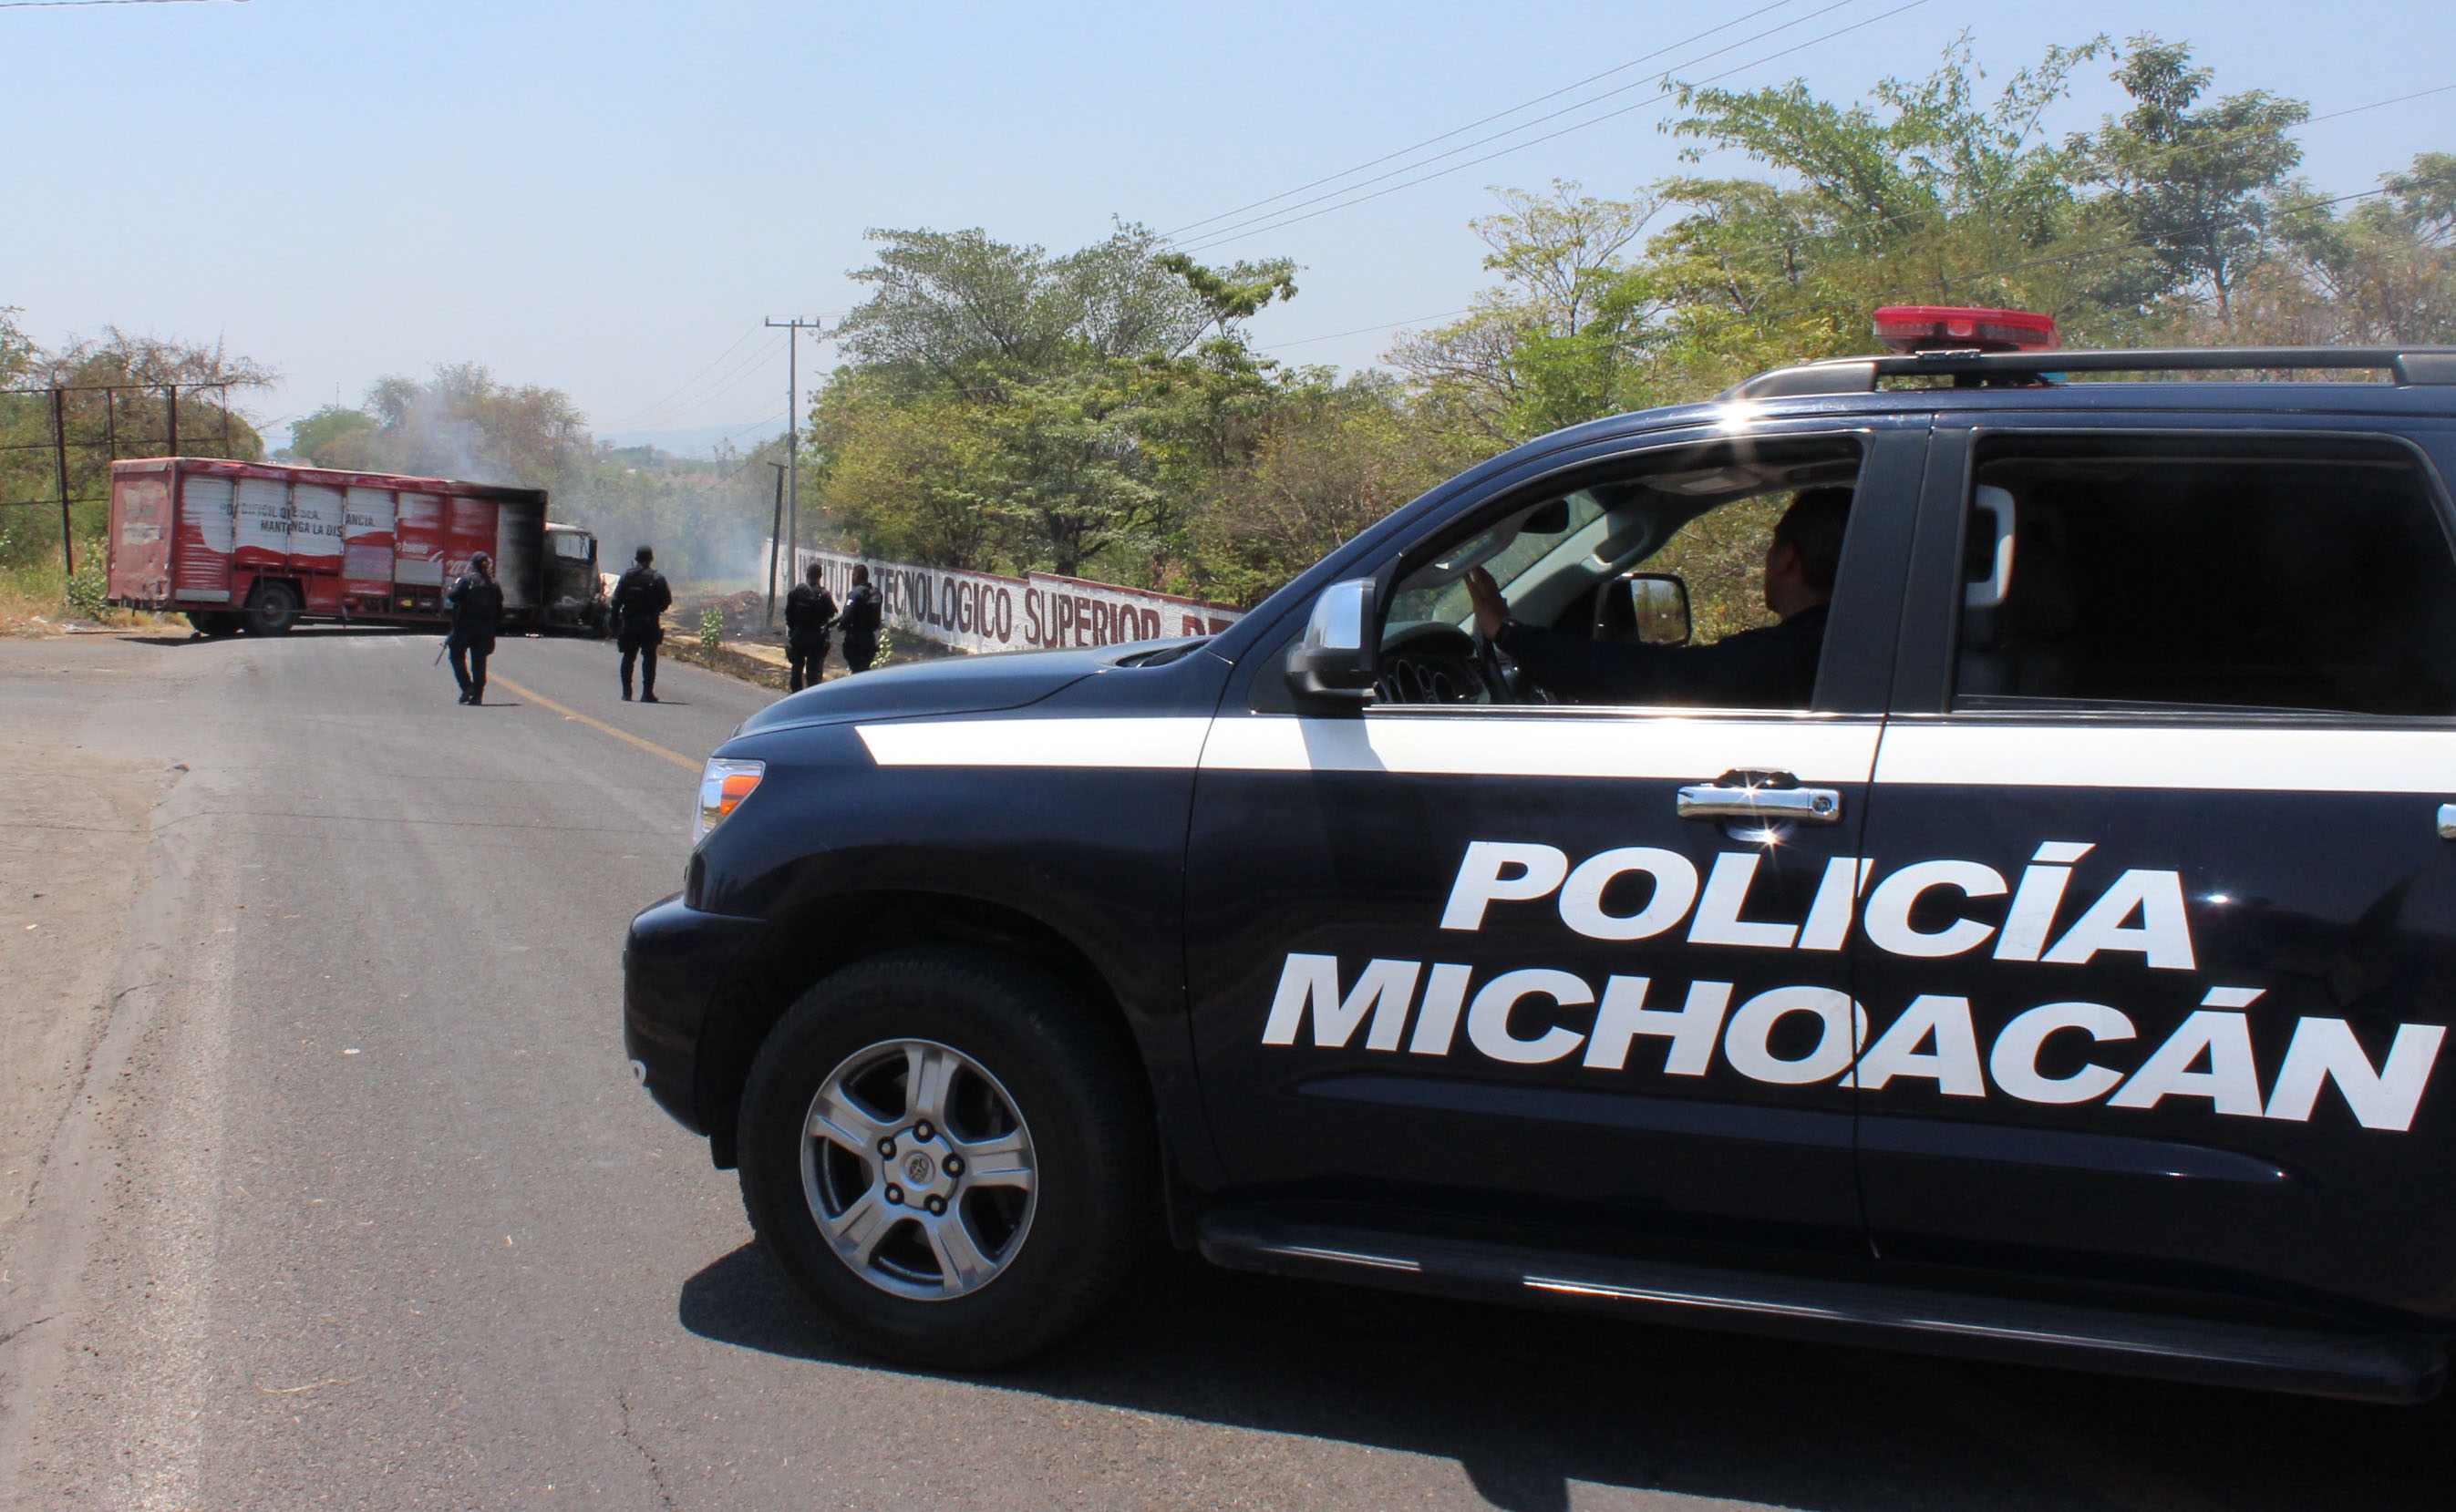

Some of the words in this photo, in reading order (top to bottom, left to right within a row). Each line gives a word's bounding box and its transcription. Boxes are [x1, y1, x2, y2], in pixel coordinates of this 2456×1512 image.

[313, 523, 325, 536] LA
[326, 513, 376, 537] DISANCIA.
[799, 553, 867, 602] INITUT
[873, 565, 1012, 644] TECNOLOGICO
[1440, 840, 2196, 971] POLICÍA
[1262, 953, 2446, 1131] MICHOACÁN
